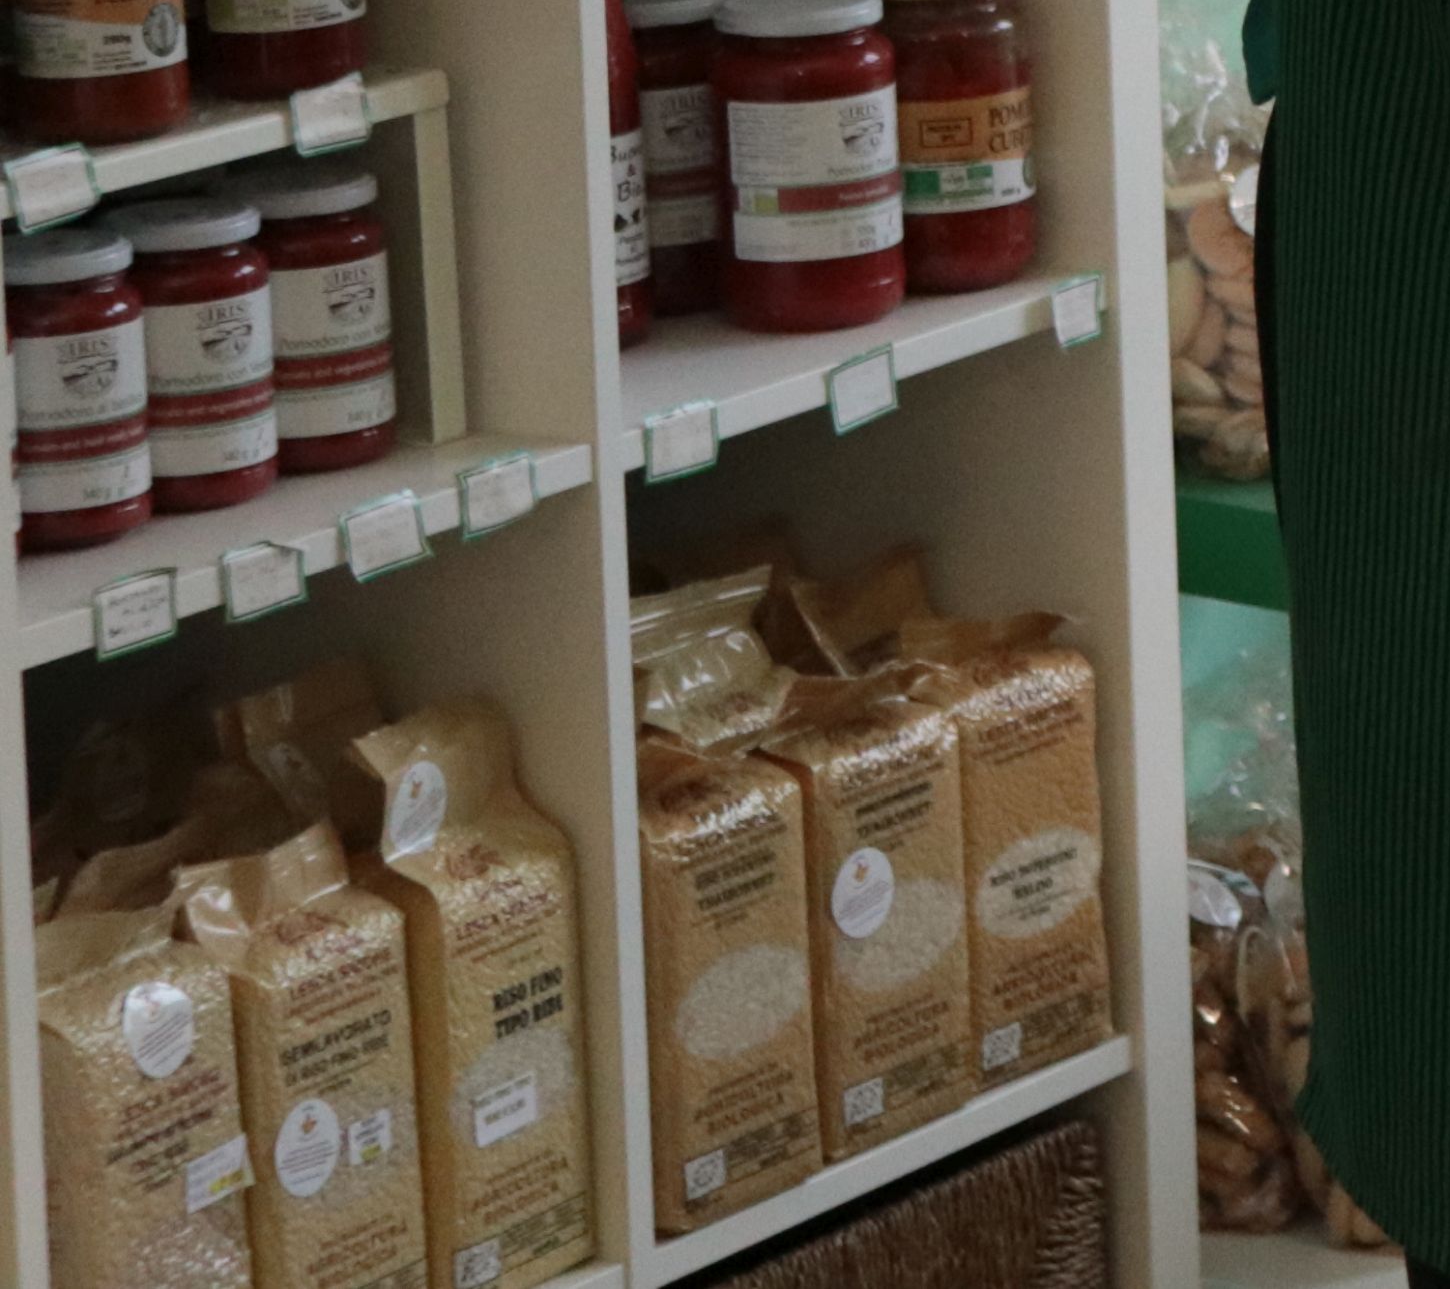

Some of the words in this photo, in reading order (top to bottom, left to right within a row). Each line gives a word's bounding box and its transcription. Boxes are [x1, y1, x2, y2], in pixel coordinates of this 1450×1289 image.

[333, 267, 367, 286] IRIS
[208, 302, 245, 321] IRIS
[70, 338, 109, 357] IRIS
[492, 982, 528, 1013] RISO
